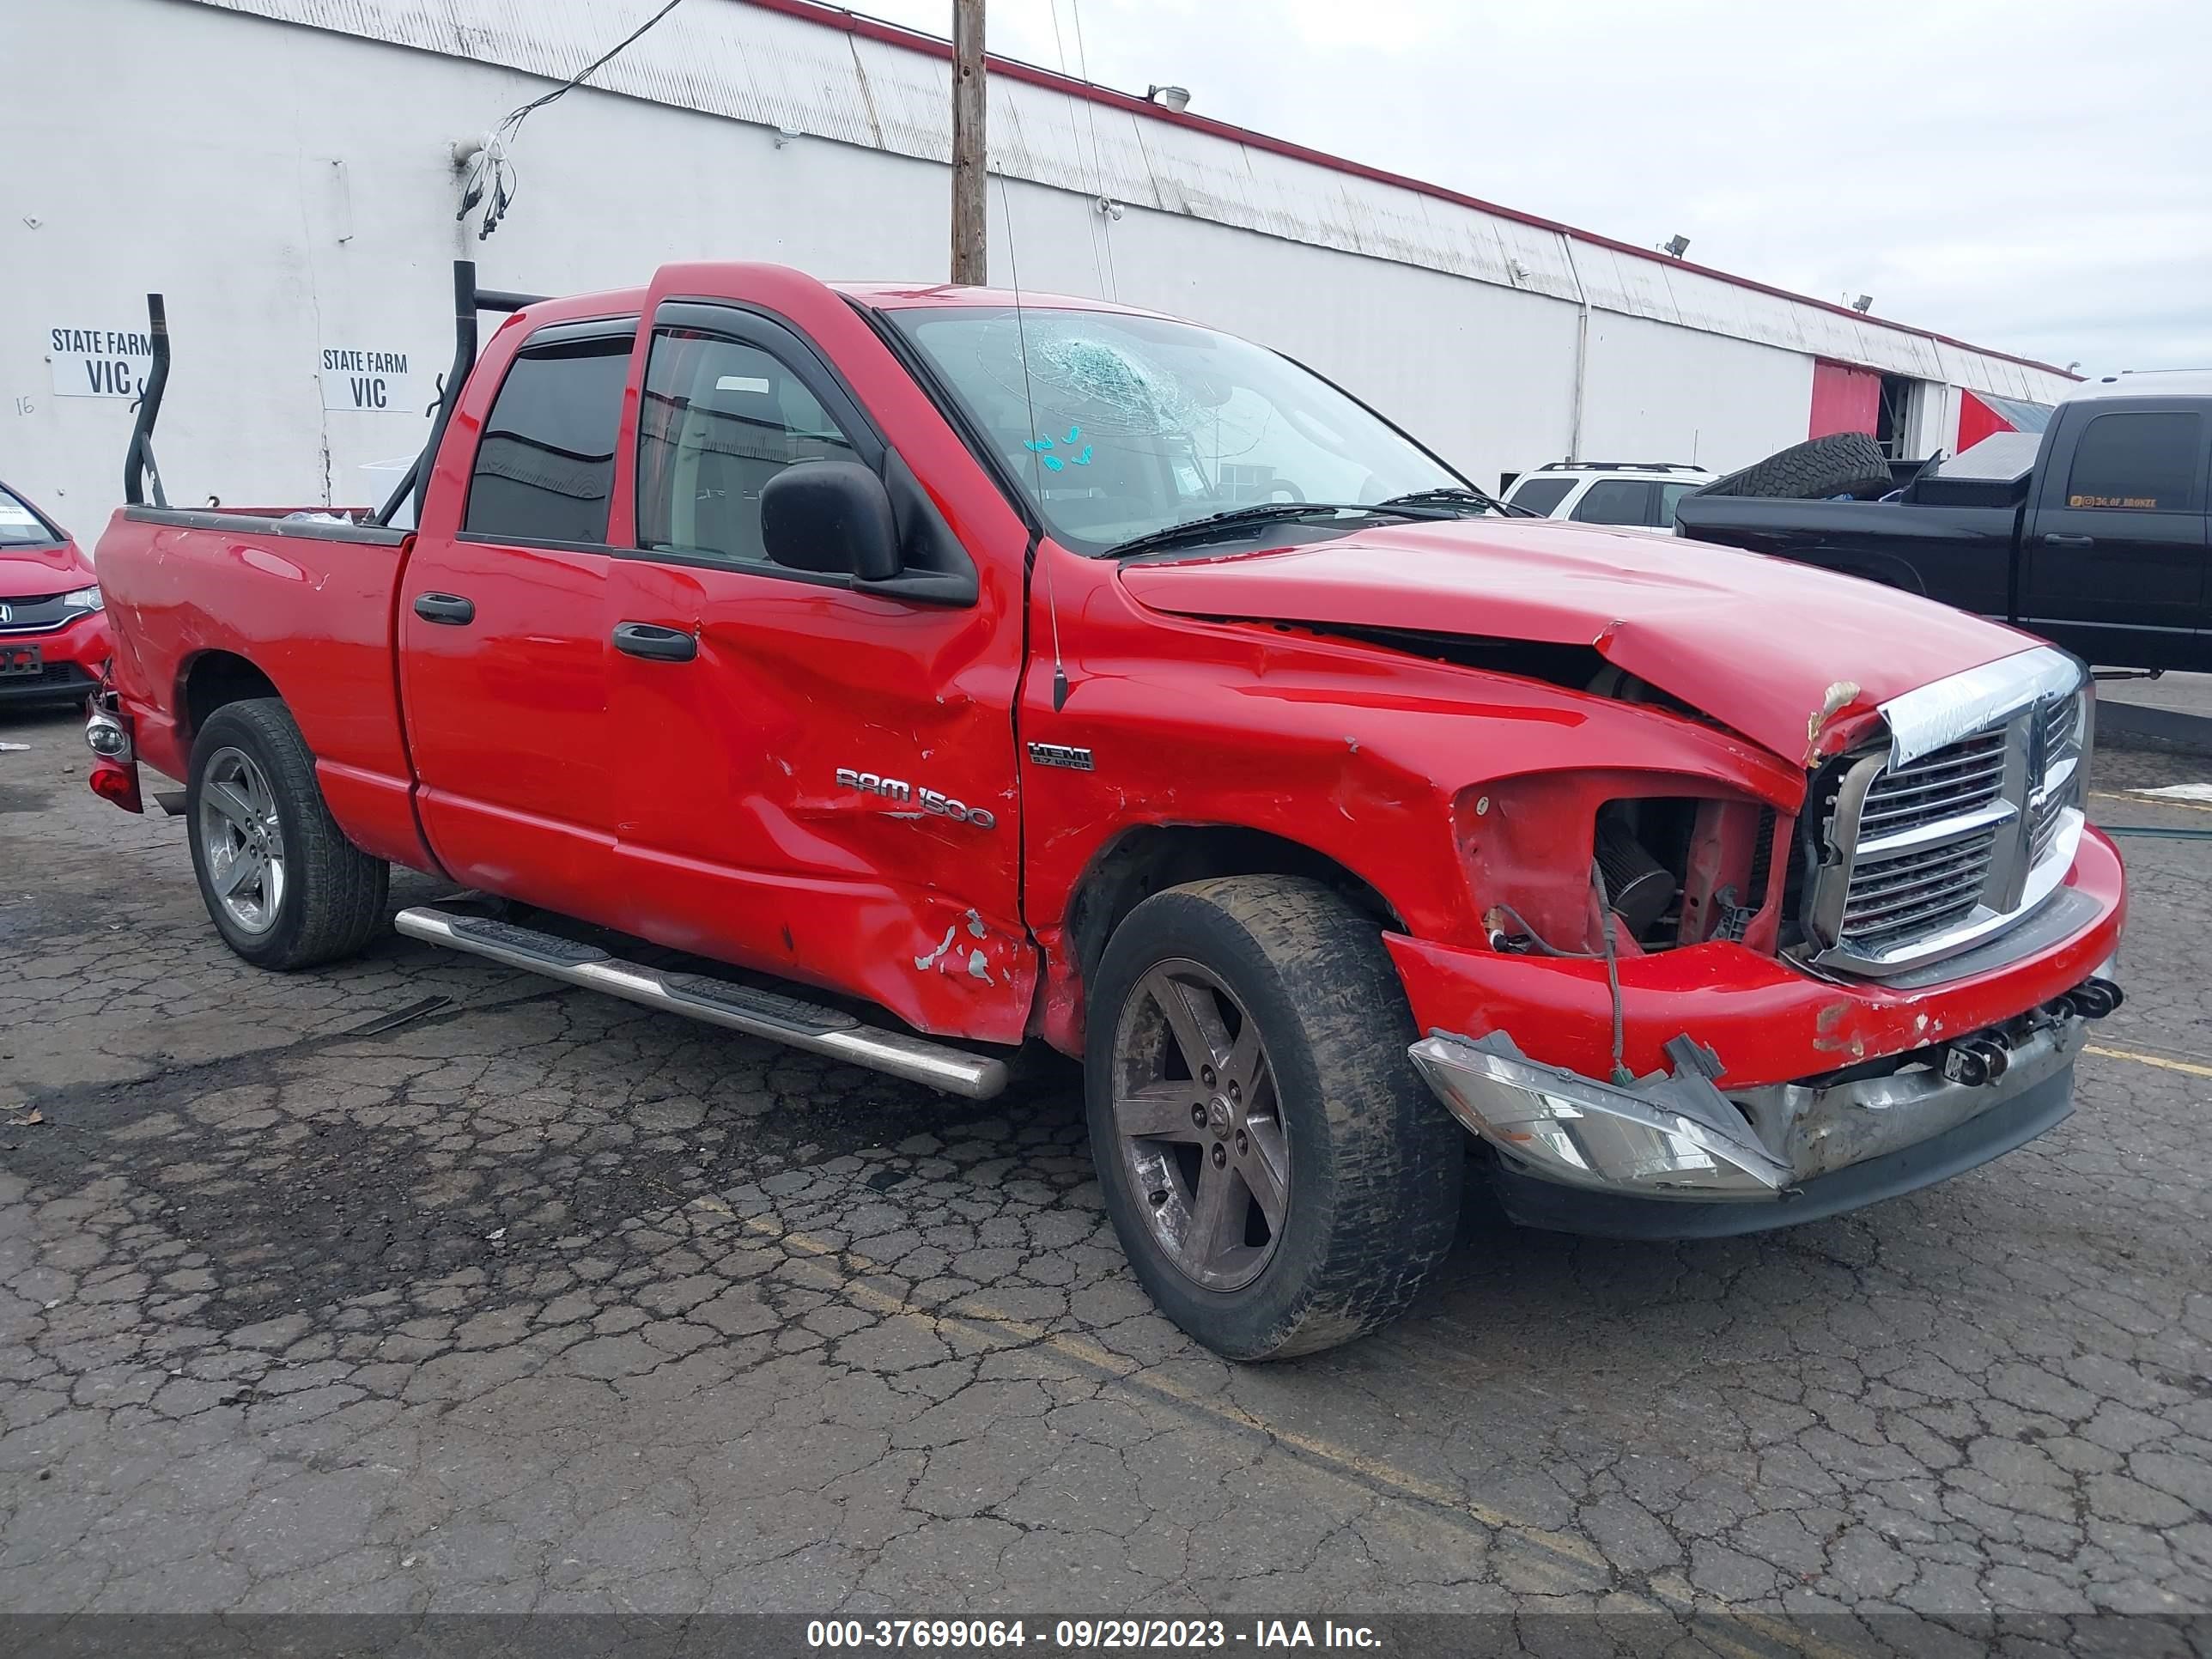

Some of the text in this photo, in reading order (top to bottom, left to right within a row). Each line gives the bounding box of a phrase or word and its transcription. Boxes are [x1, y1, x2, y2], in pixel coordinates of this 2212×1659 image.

[52, 328, 103, 354] STATE
[323, 349, 408, 374] STATE FARM
[85, 359, 131, 395] VIC
[350, 377, 386, 408] VIC
[15, 395, 35, 416] 16
[1027, 741, 1092, 763] HEMI
[1054, 759, 1091, 769] LITER
[836, 768, 996, 830] RAM 1500
